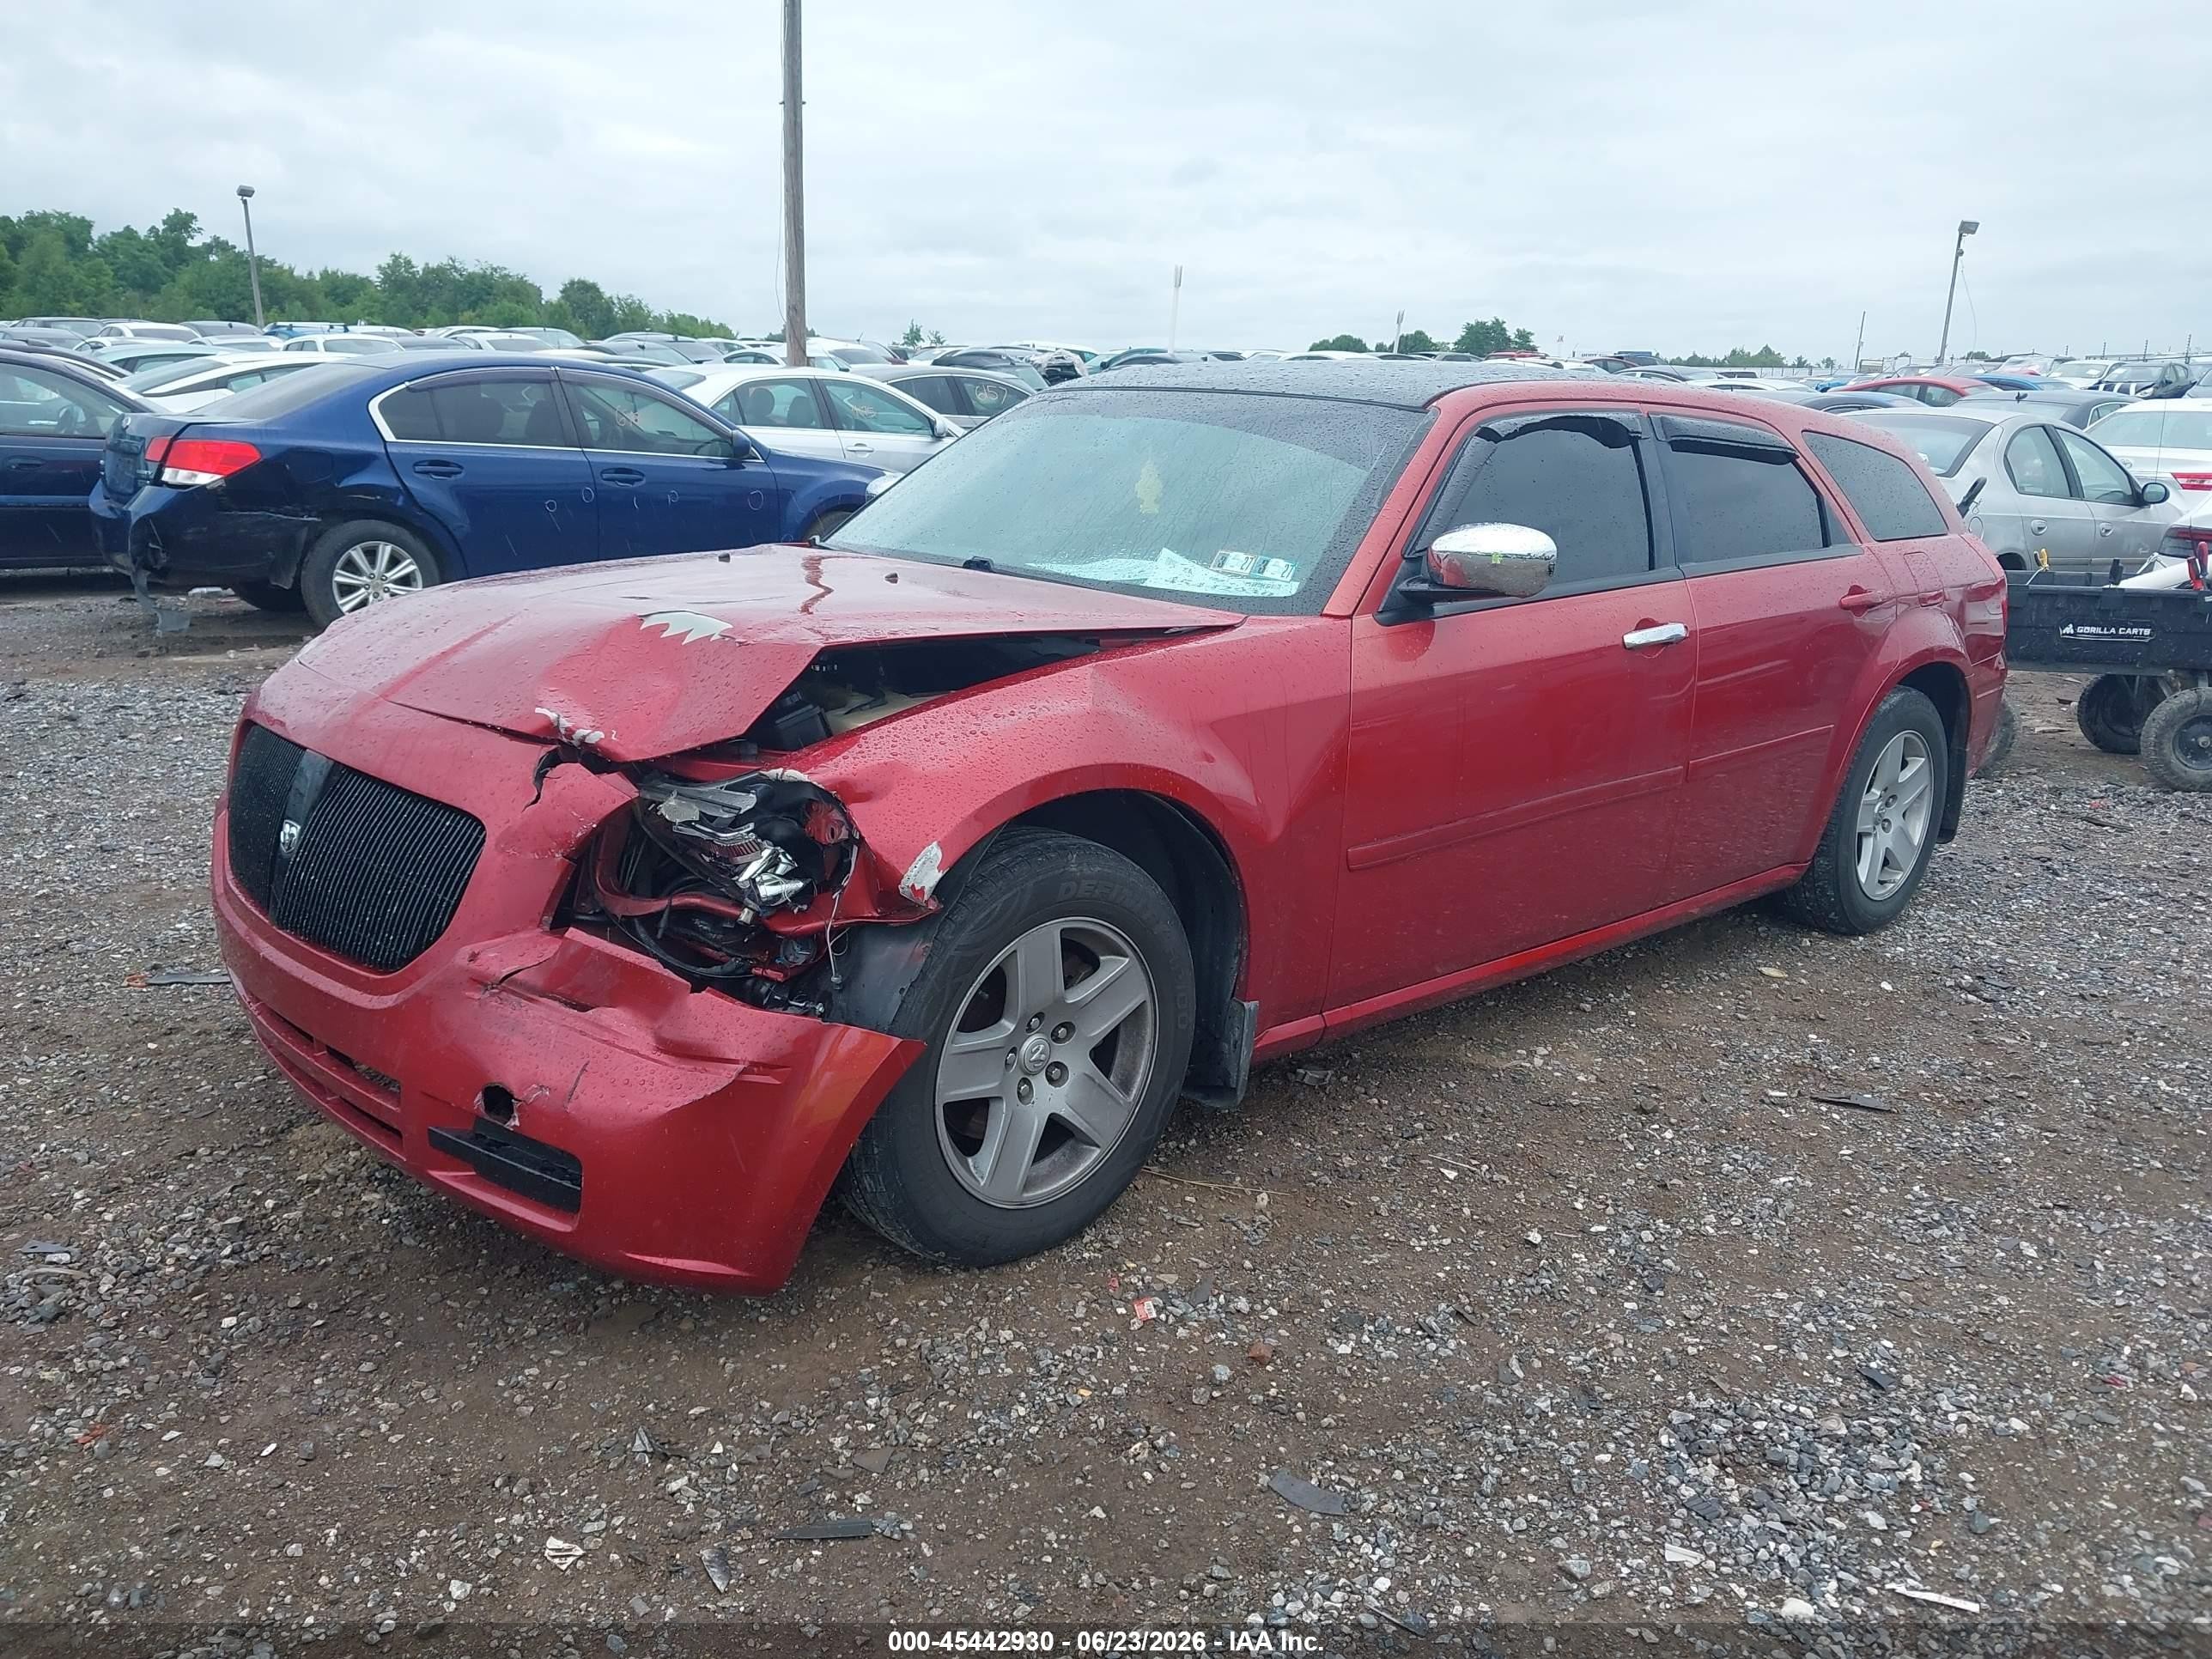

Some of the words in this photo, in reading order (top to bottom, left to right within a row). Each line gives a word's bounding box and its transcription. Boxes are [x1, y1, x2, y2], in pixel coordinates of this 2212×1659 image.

[1240, 556, 1255, 571] 27
[1280, 563, 1296, 579] 27
[2076, 625, 2116, 635] GORILLA
[2118, 627, 2151, 636] CARTS
